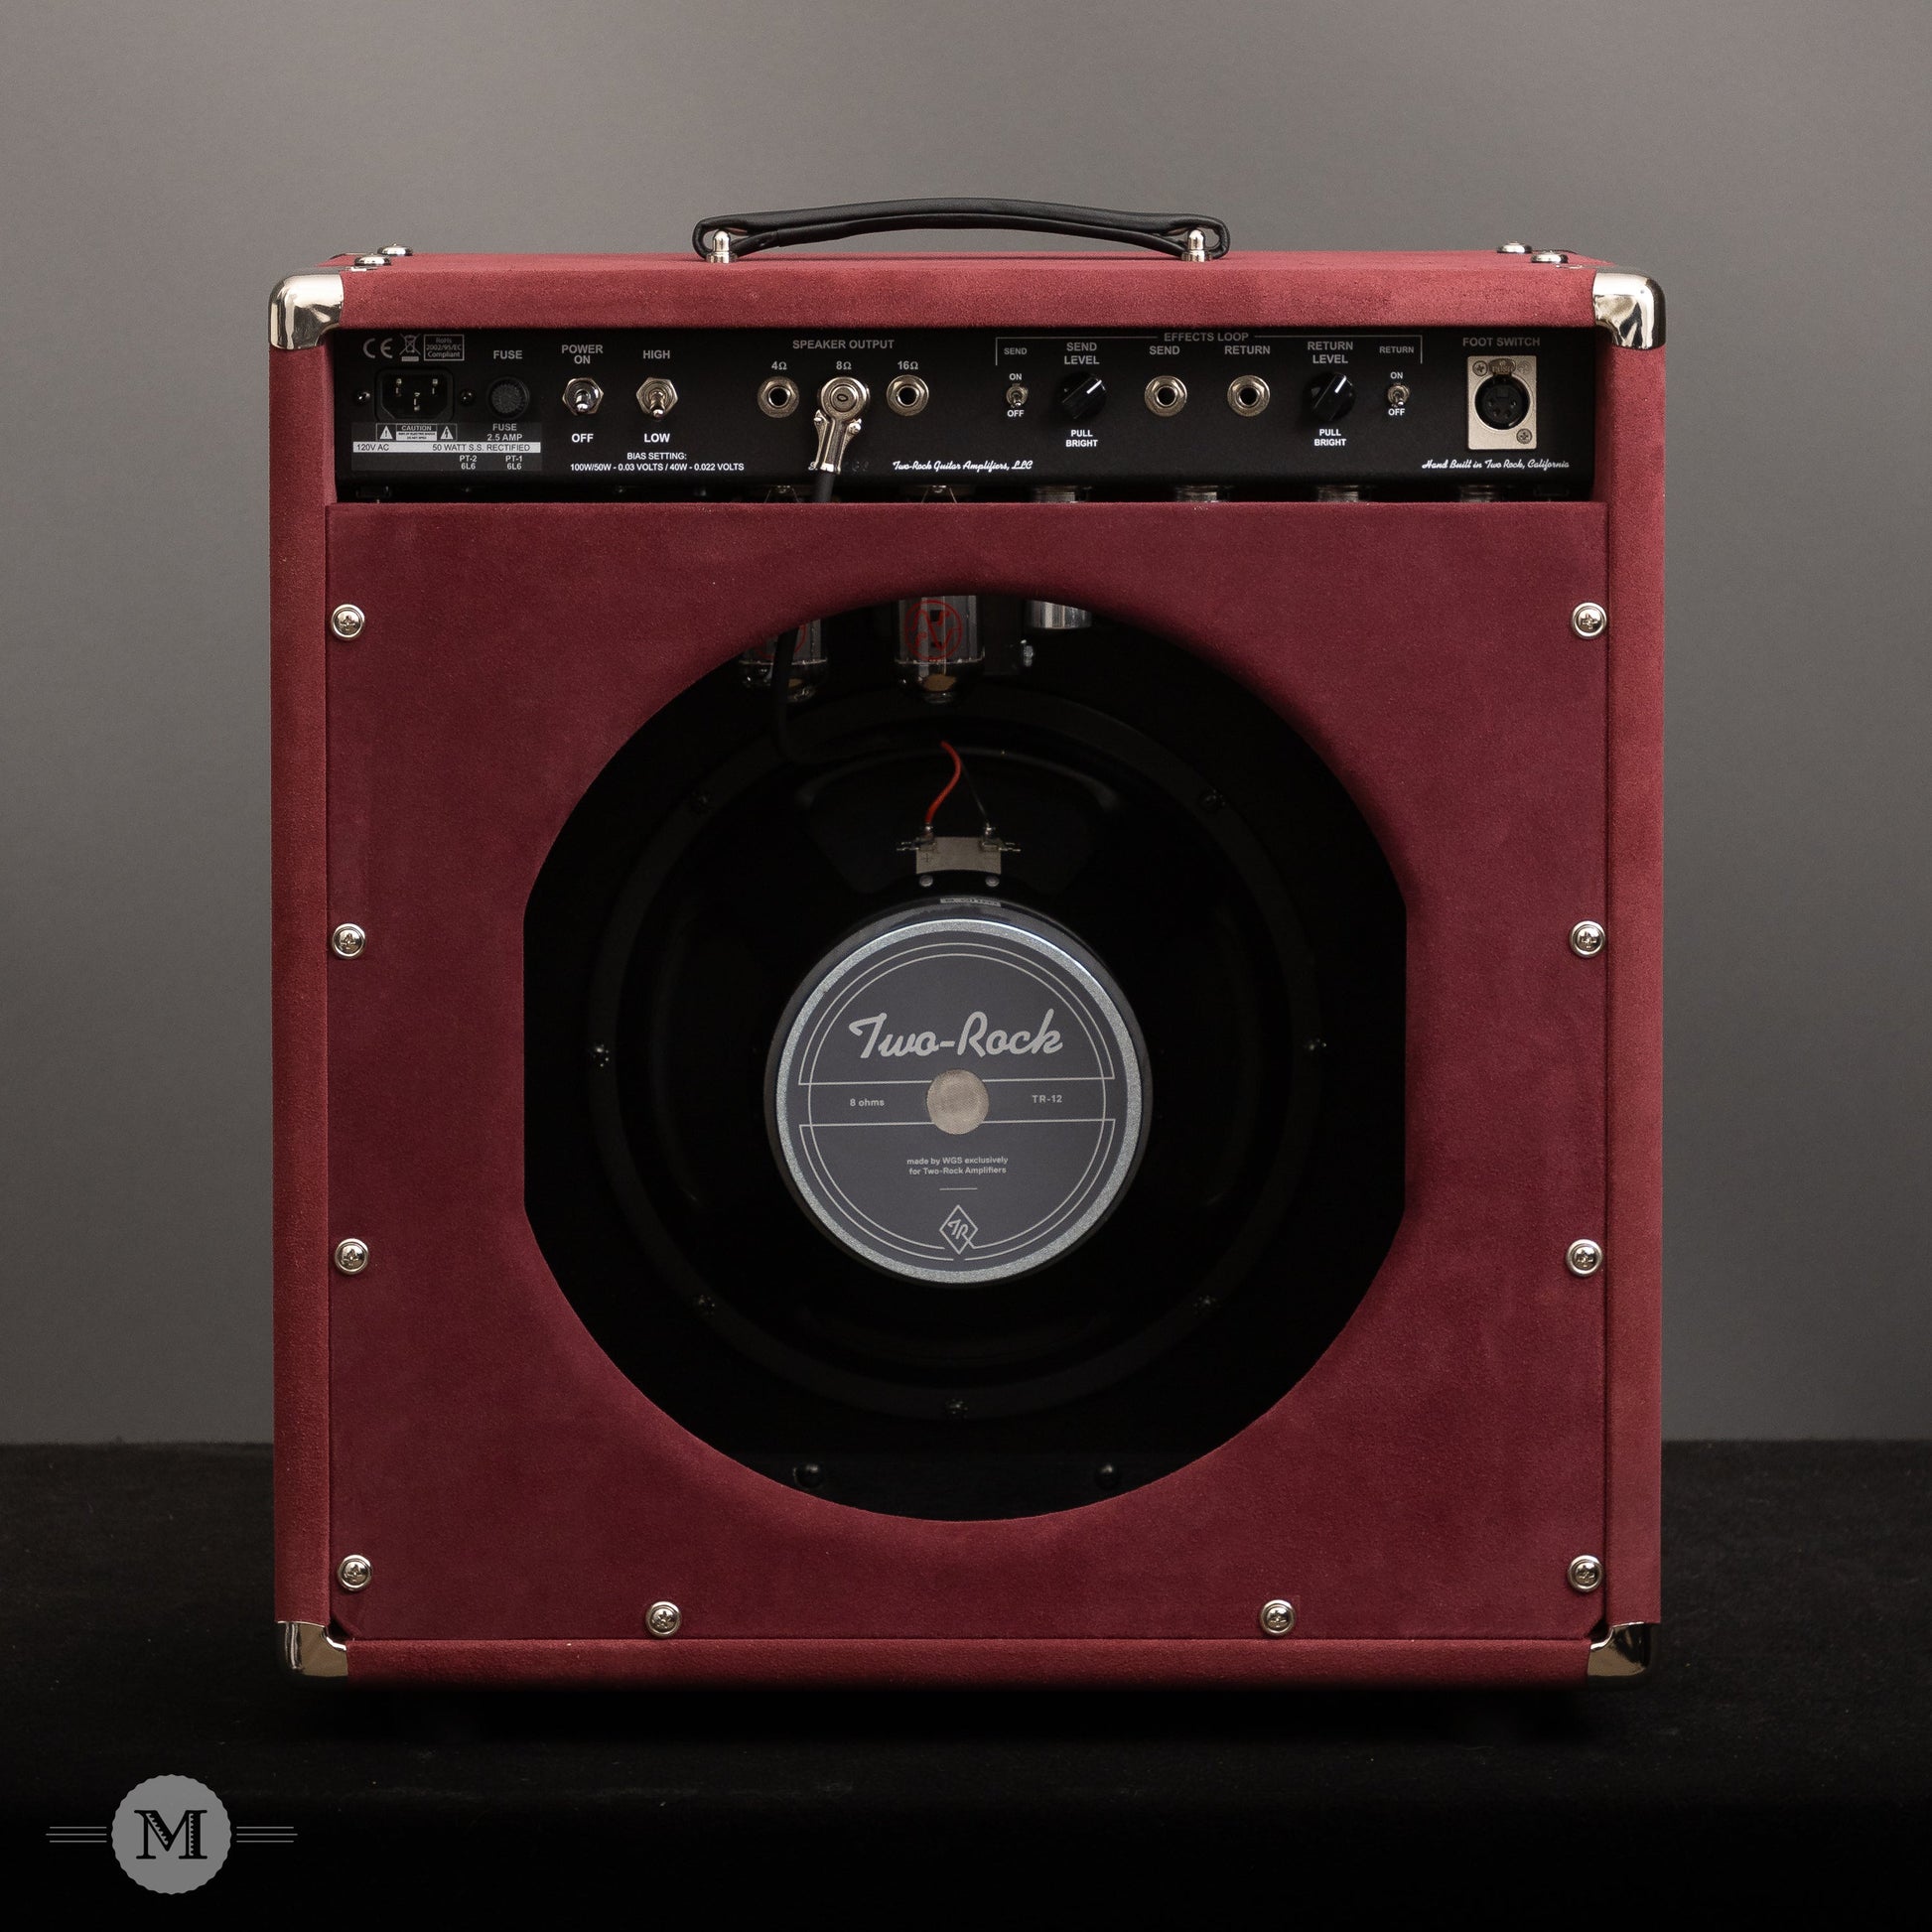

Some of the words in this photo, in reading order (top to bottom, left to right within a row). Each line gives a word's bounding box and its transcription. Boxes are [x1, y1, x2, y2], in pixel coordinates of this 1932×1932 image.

[1164, 333, 1214, 343] EFFECTS
[1217, 333, 1249, 343] LOOP
[1462, 338, 1493, 346] FOOT
[1496, 338, 1540, 346] SWITCH
[792, 340, 846, 349] SPEAKER
[849, 340, 895, 349] OUTPUT
[1066, 343, 1097, 351] SEND
[1308, 342, 1353, 350] RETURN
[561, 345, 604, 354] POWER
[1149, 345, 1180, 355] SEND
[1224, 345, 1271, 354] RETURN
[493, 350, 522, 359] FUSE
[642, 350, 670, 359] HIGH
[1312, 354, 1349, 364] LEVEL
[574, 355, 591, 364] ON
[1063, 355, 1100, 364] LEVEL
[771, 360, 787, 370] 4Ω
[836, 360, 852, 370] 8Ω
[897, 360, 918, 370] 16Ω
[571, 433, 594, 443] OFF
[644, 433, 670, 443] LOW
[893, 460, 932, 471] Two-Rock
[933, 460, 961, 473] Guitar
[962, 460, 1010, 473] Amplifiers,
[1012, 460, 1034, 470] LLC
[1421, 459, 1449, 469] Hand
[1449, 459, 1471, 469] Built
[1472, 460, 1482, 469] in
[1484, 459, 1502, 469] Two
[1503, 459, 1525, 470] Rock,
[1527, 459, 1570, 472] California
[849, 1008, 1063, 1058] Two-Rock
[850, 1098, 856, 1107] 8
[858, 1098, 885, 1107] ohms
[1032, 1094, 1062, 1103] TR-12
[930, 1158, 940, 1167] by
[964, 1156, 1009, 1165] exclusively
[965, 1167, 1007, 1175] Amplifiers
